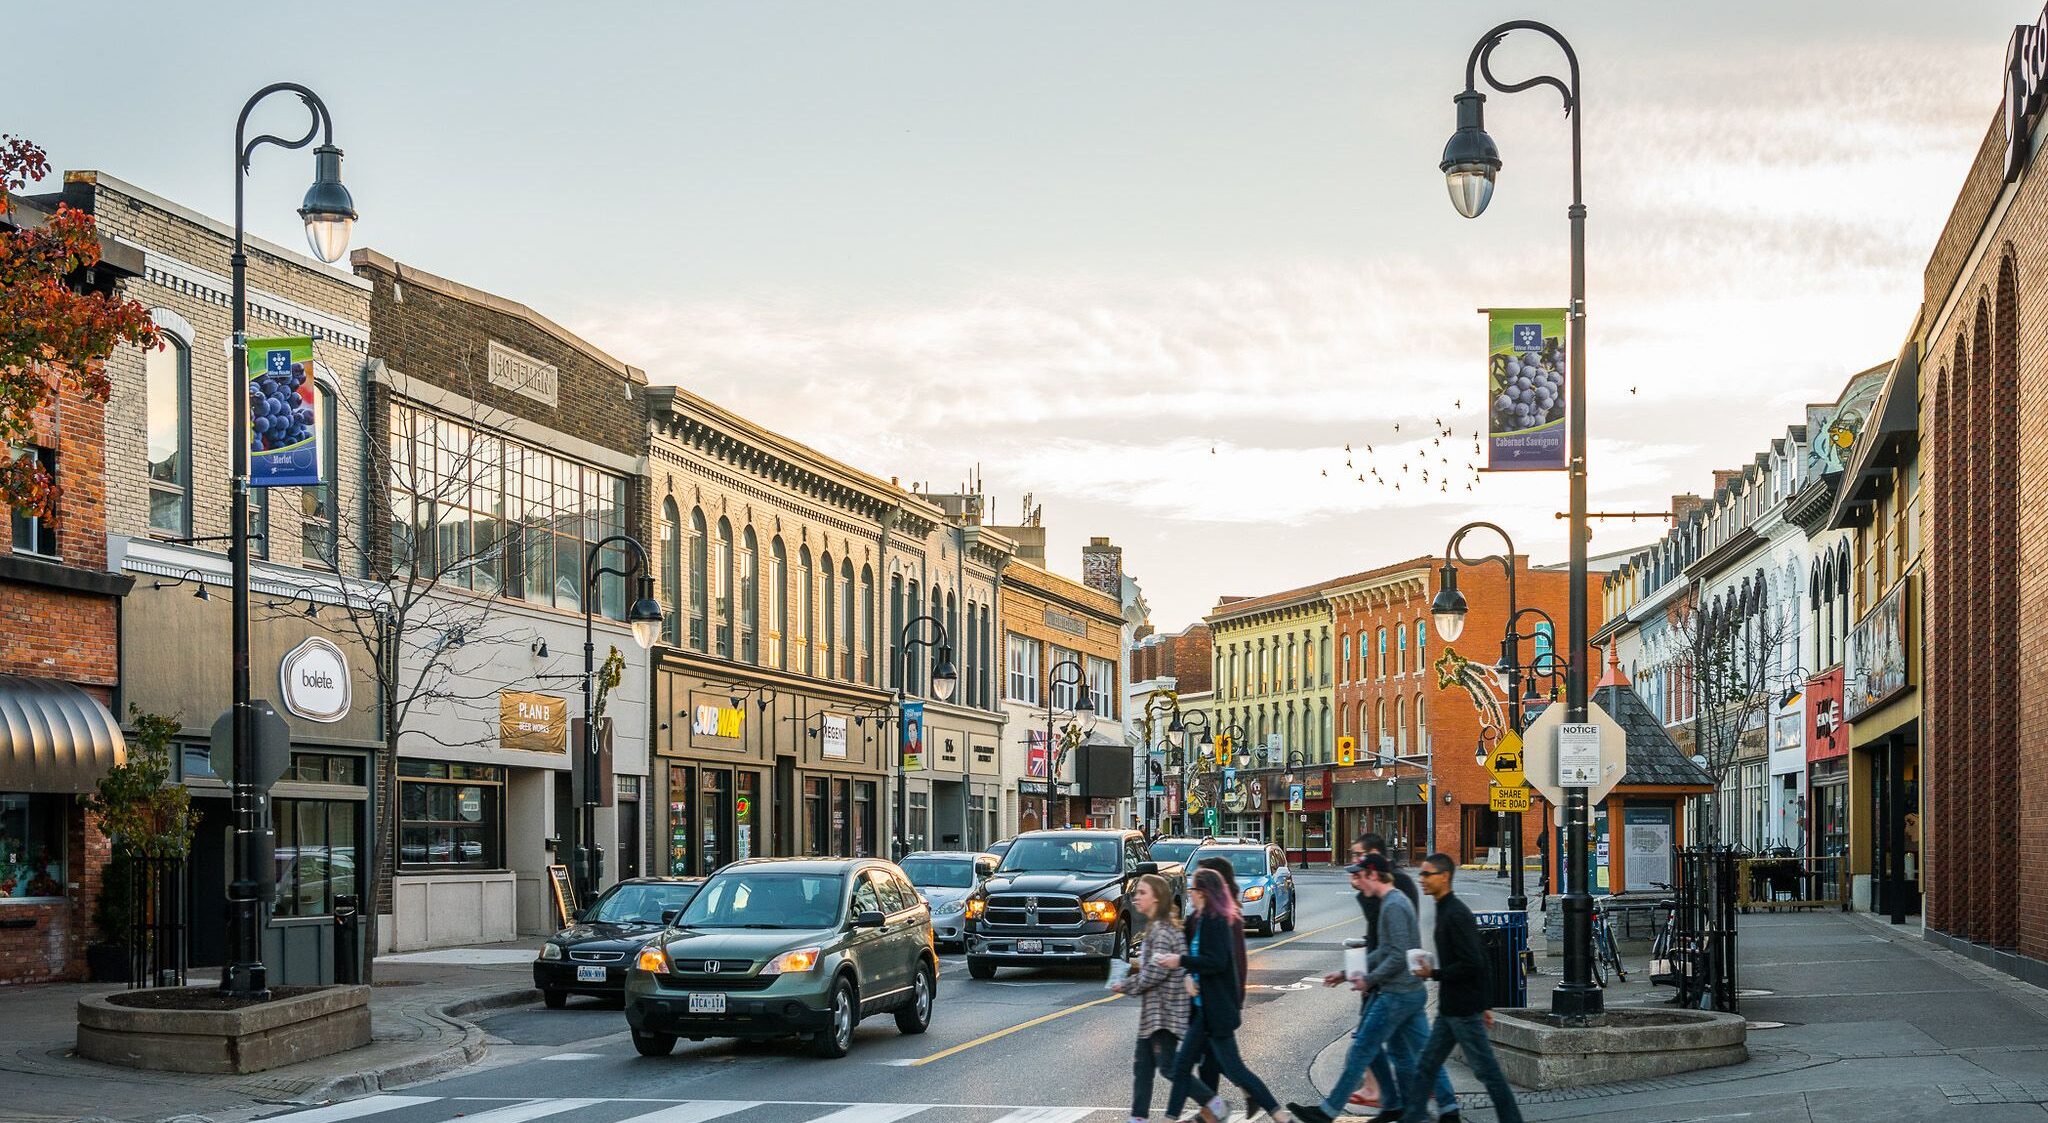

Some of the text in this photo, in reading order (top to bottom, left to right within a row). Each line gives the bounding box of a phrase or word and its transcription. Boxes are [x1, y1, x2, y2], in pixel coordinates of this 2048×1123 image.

[490, 351, 550, 395] HOFFMAN
[1495, 437, 1559, 449] Cabernet Sauvignon
[273, 454, 292, 464] Merlot
[518, 702, 550, 721] PLAN B
[692, 704, 746, 739] SUBWAY
[1563, 725, 1598, 734] NOTICE
[1498, 789, 1522, 798] SHARE
[1493, 799, 1528, 809] THE ROAD
[1207, 809, 1215, 819] P
